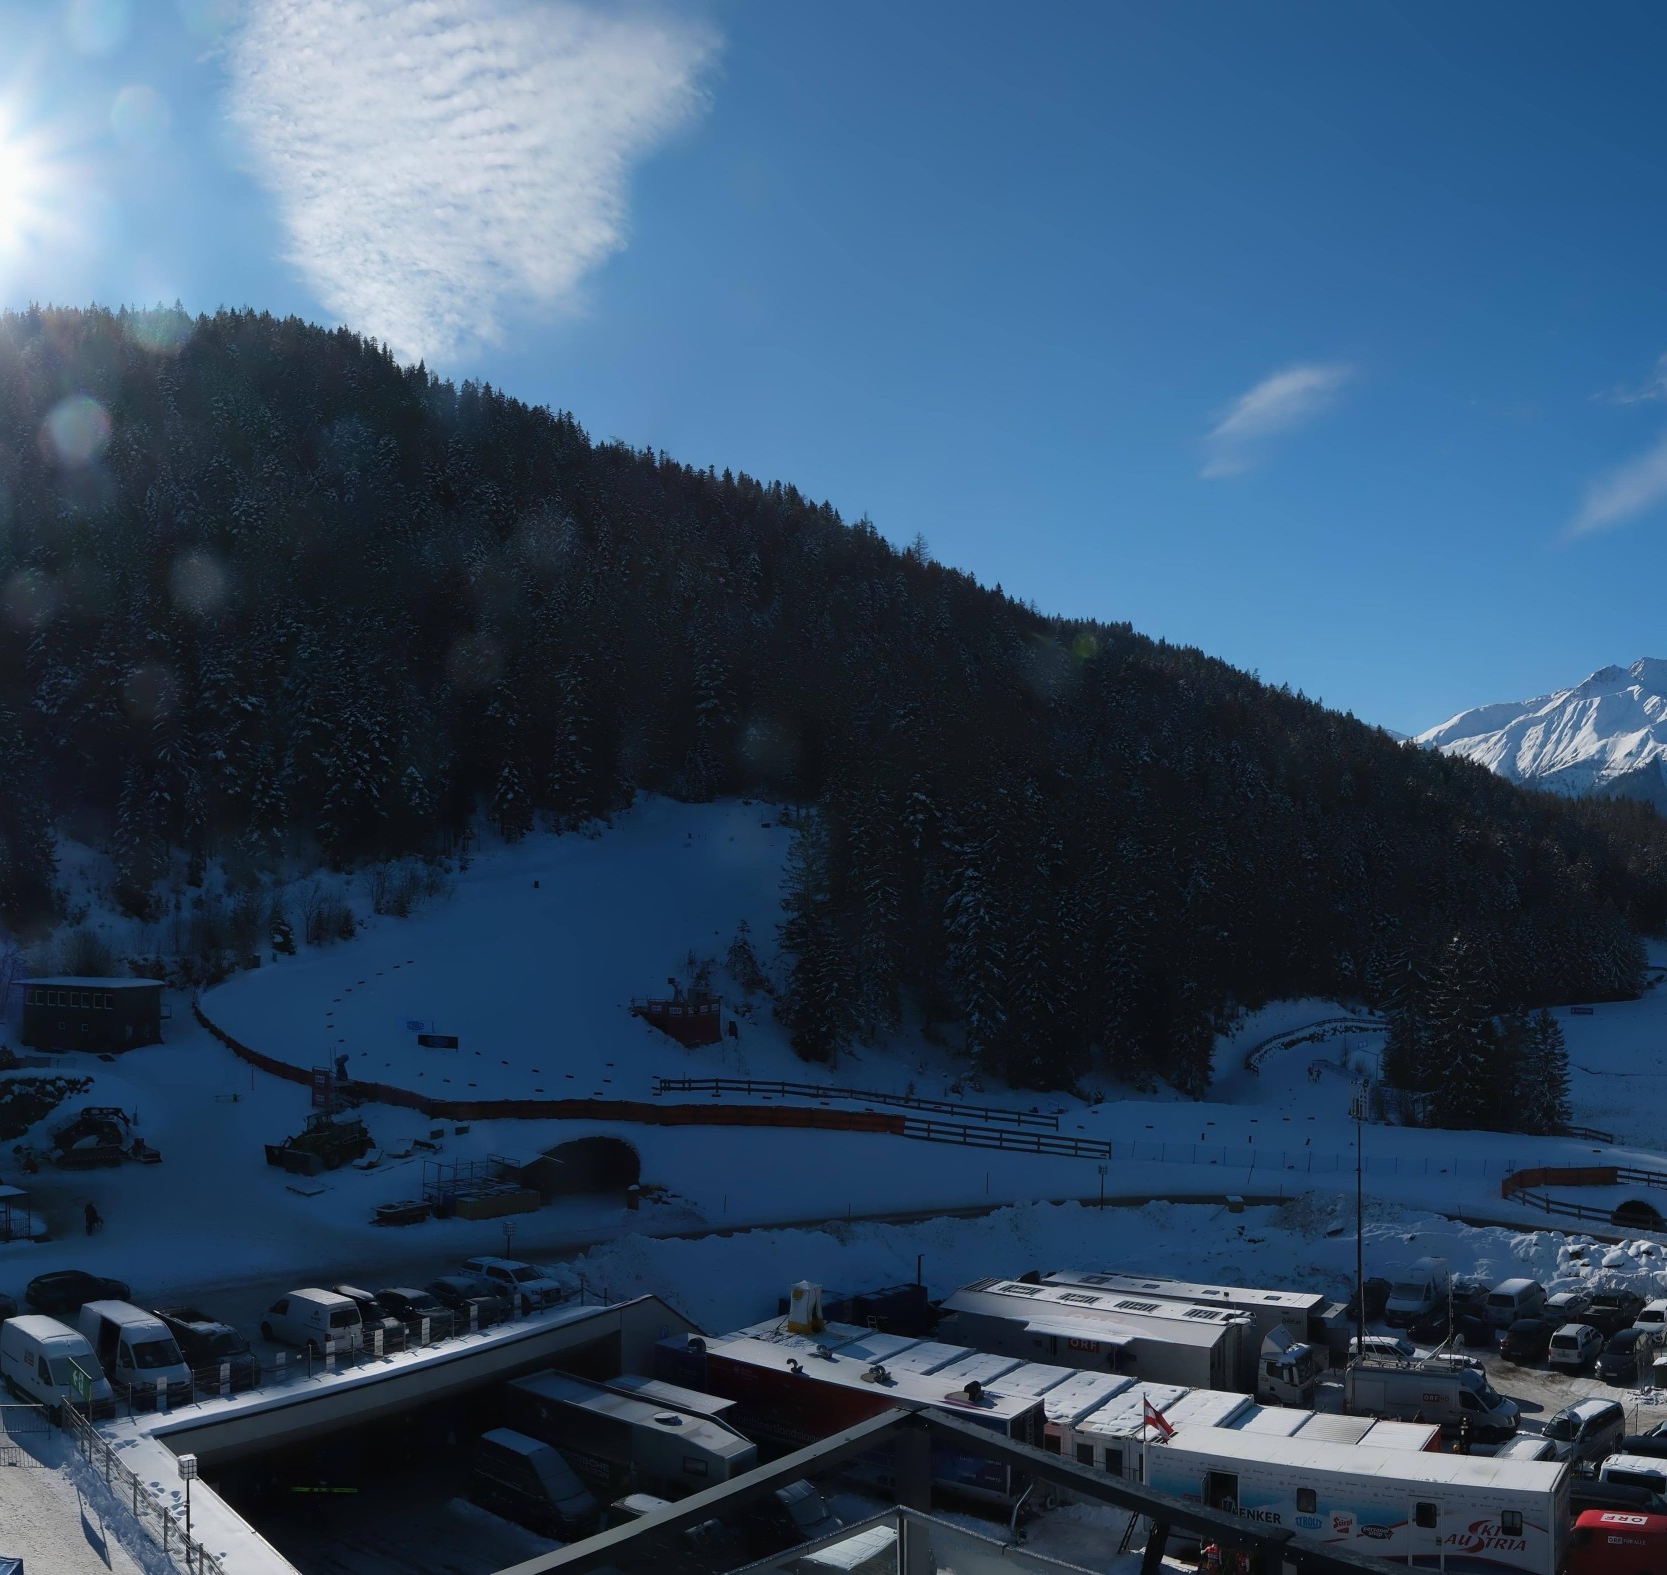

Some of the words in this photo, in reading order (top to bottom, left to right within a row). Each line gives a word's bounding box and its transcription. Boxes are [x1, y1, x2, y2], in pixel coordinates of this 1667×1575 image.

[1070, 1338, 1098, 1351] ORF
[1423, 1395, 1439, 1403] ORF
[1239, 1508, 1282, 1524] ENKER
[1605, 1515, 1643, 1523] ORF
[1334, 1517, 1353, 1529] Stiegl
[1444, 1533, 1527, 1553] AUSTRIA
